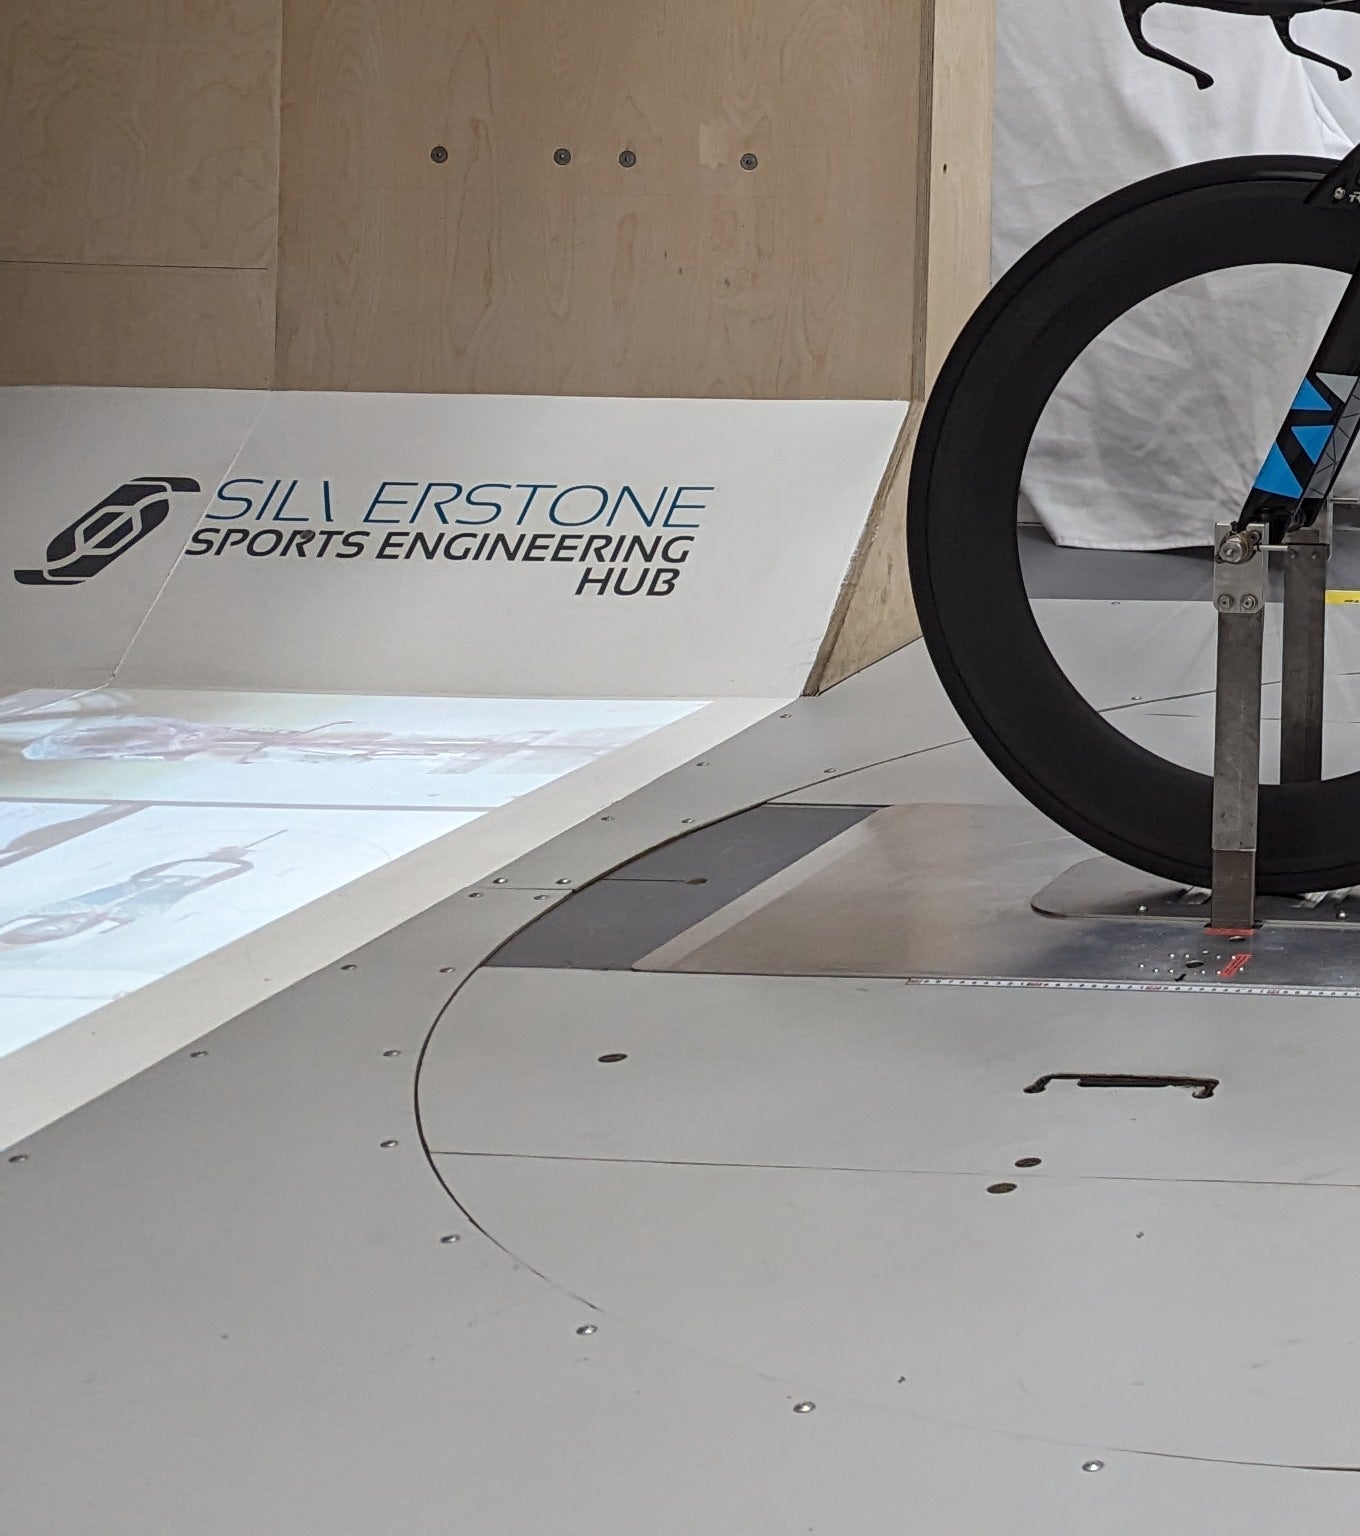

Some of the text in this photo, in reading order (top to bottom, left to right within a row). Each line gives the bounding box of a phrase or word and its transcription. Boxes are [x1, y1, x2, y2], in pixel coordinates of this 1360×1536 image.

[184, 527, 695, 564] SPORTS ENGINEERING
[574, 567, 681, 597] HUB
